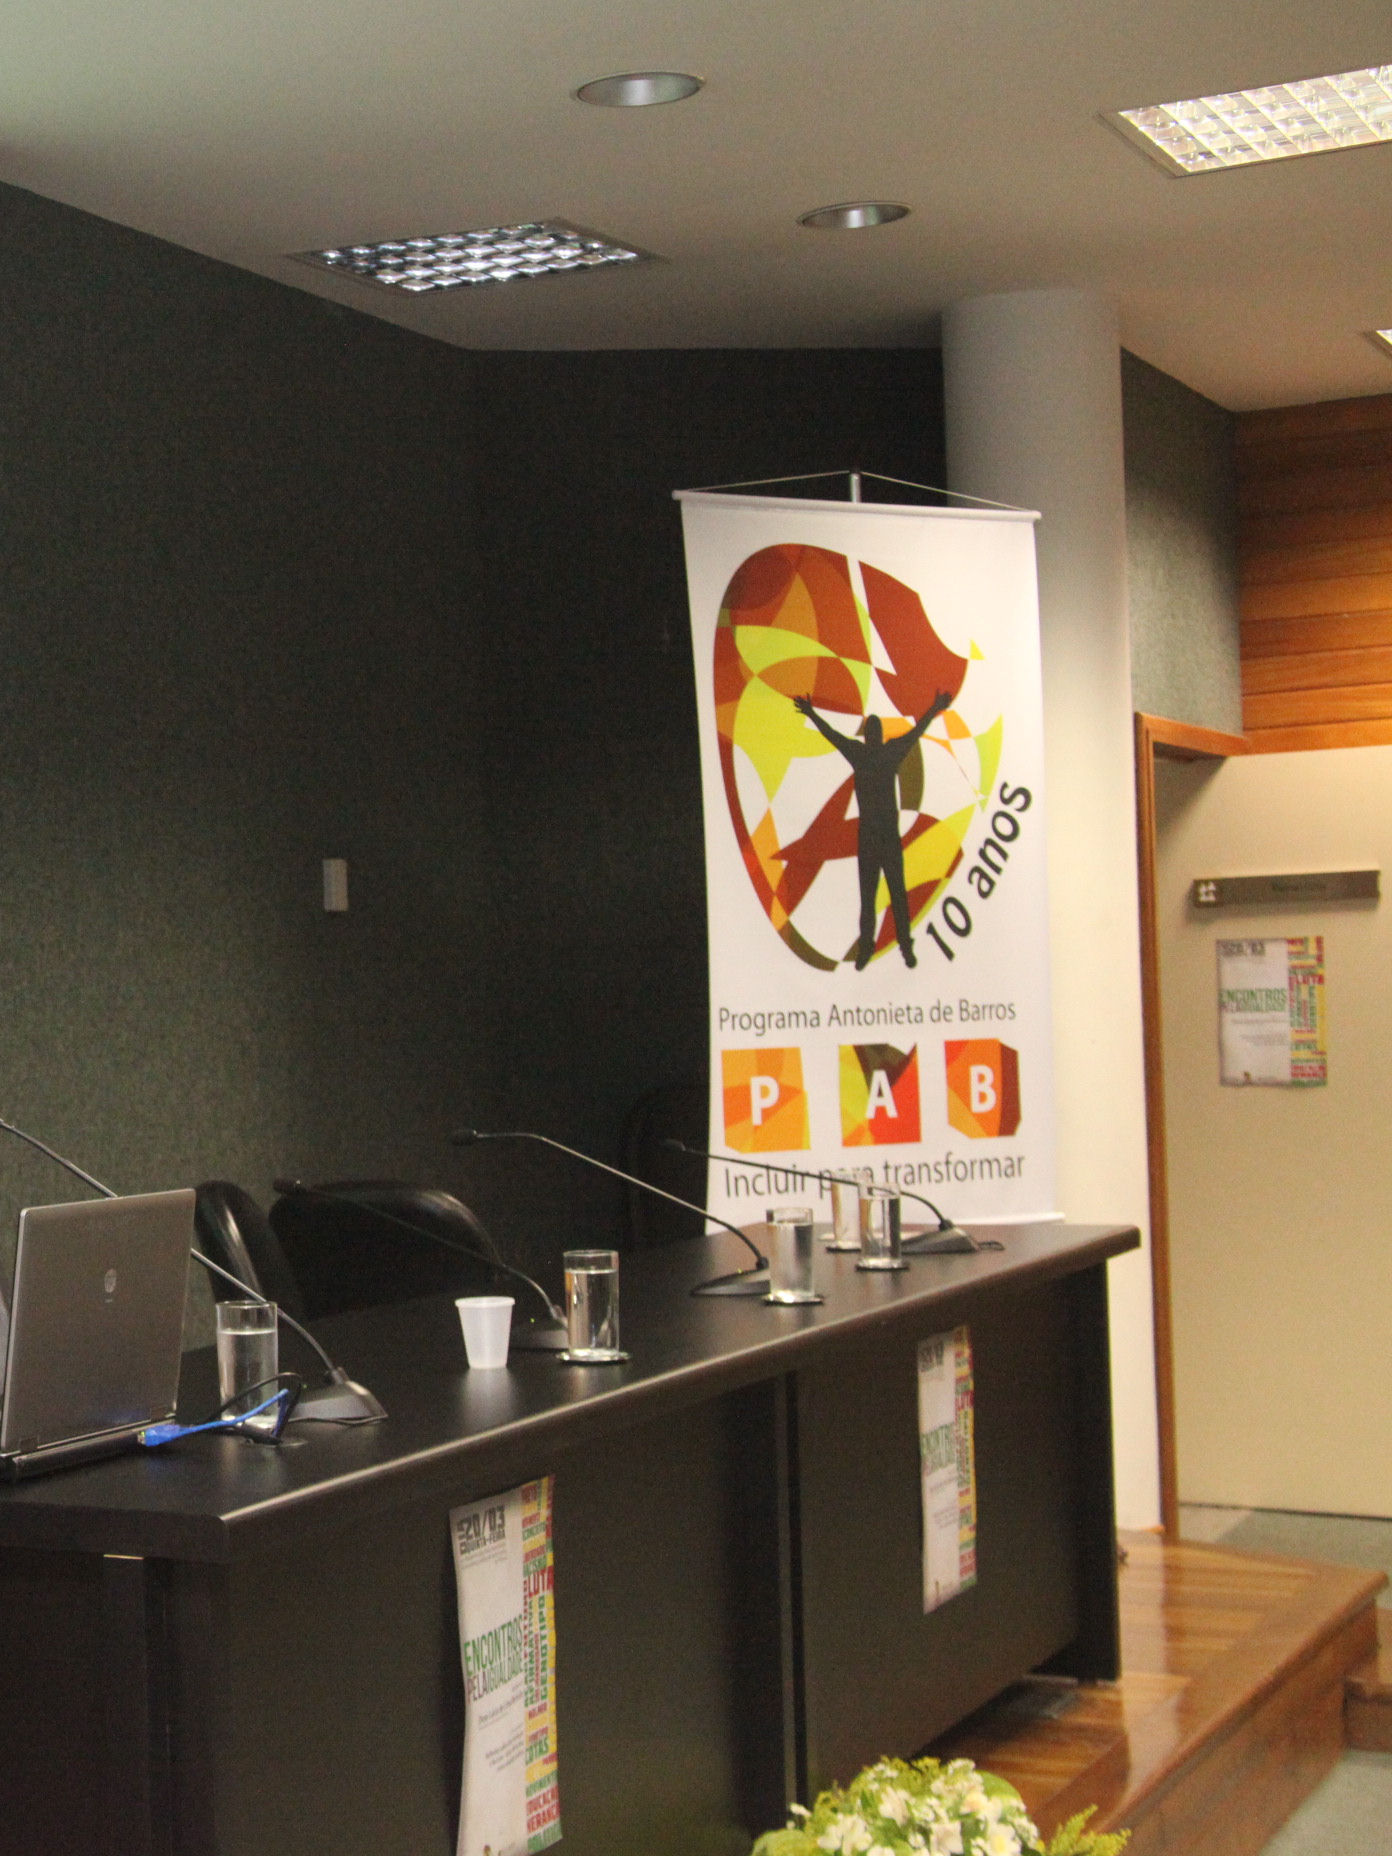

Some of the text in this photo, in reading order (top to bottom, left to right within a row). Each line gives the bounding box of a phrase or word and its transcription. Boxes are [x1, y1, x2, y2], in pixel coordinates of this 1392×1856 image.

[926, 781, 1033, 962] 10 anos
[719, 998, 1016, 1037] Programa Antonieta de Barros
[750, 1064, 996, 1126] P A B
[724, 1164, 807, 1197] Incluir
[883, 1152, 1025, 1187] transformar
[464, 1614, 523, 1676] ENCONTROS
